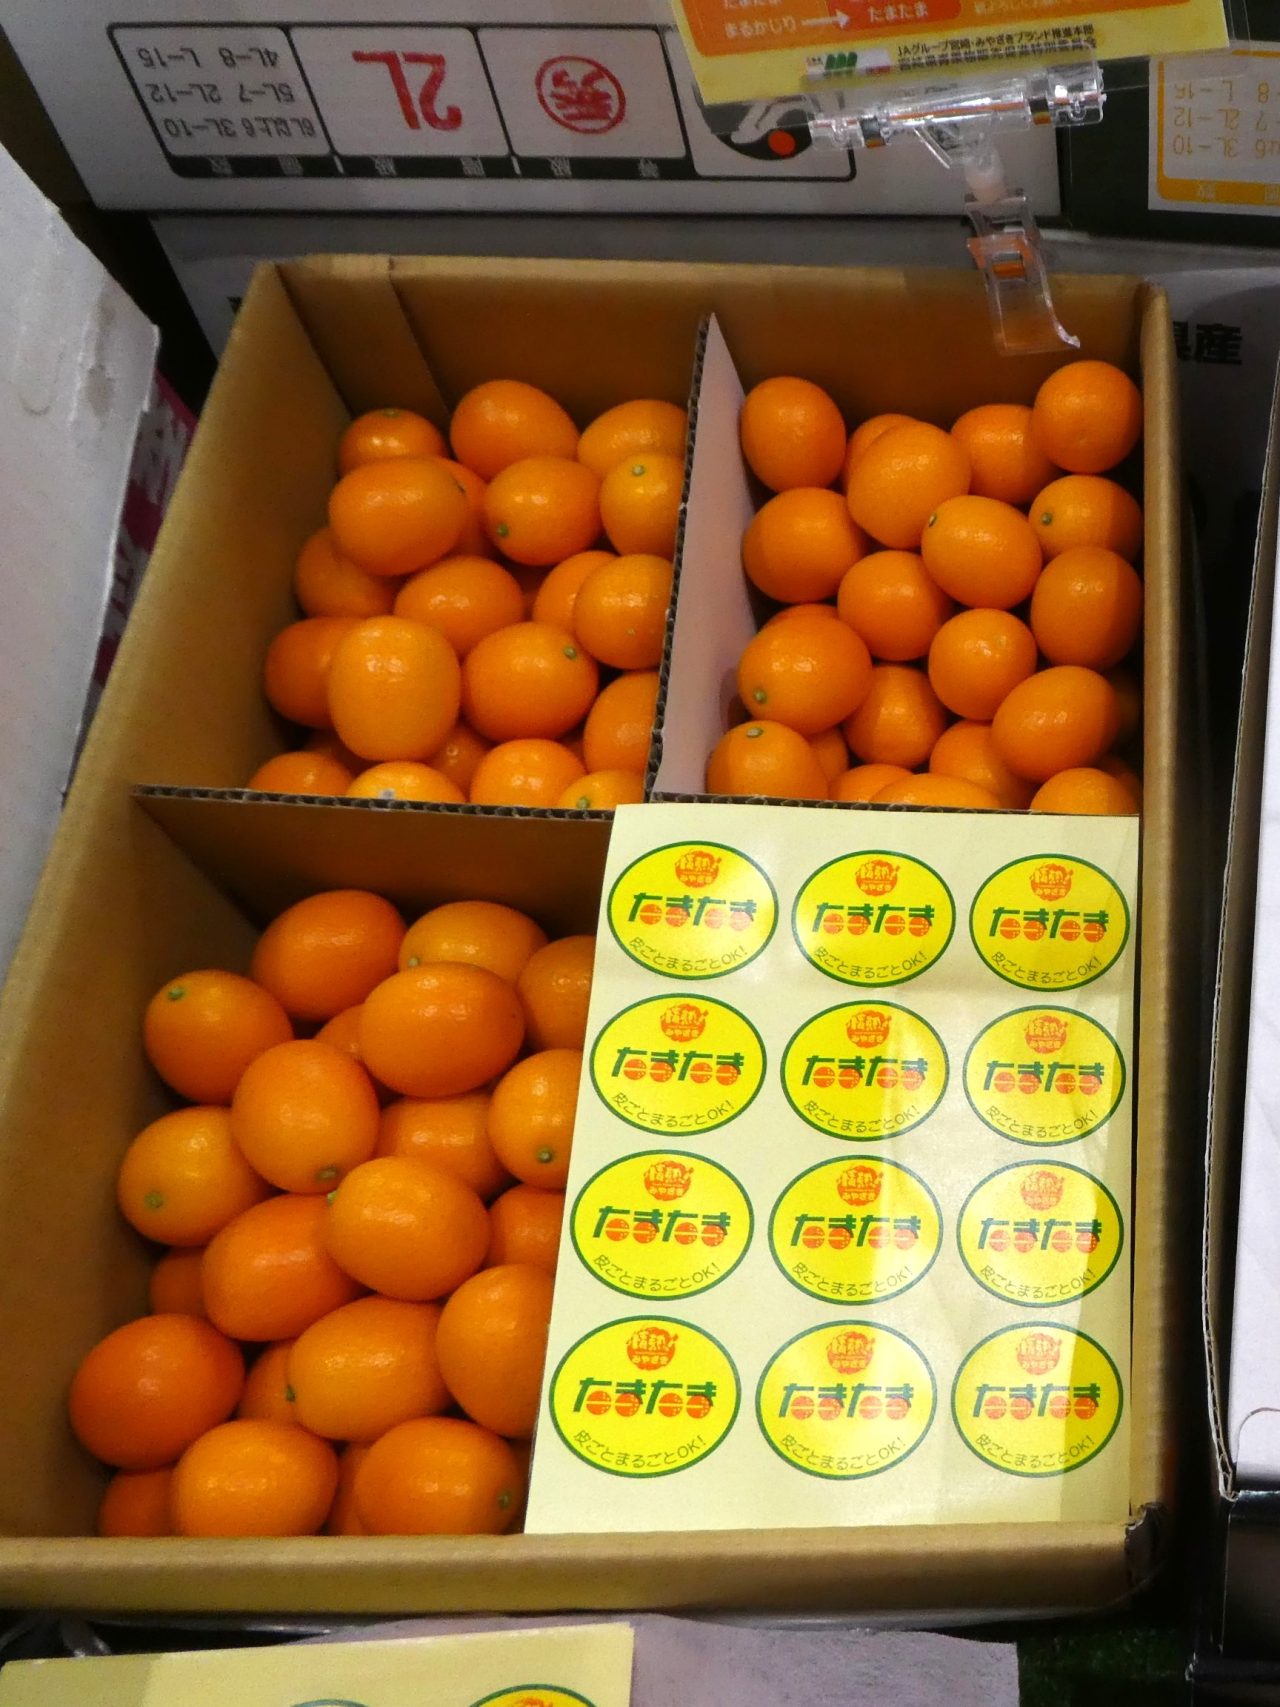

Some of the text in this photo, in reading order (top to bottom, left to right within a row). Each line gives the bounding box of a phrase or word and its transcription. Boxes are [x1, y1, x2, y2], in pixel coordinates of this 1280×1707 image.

[352, 50, 463, 131] 2L
[629, 892, 757, 931] たまたま
[811, 902, 935, 937] たまたま
[990, 906, 1109, 943] たまたま
[629, 937, 749, 971] 皮ごとまるごとOK!
[813, 945, 927, 979] 皮ごとまるごとOK!
[991, 951, 1101, 983] 皮ごとまるごとOK!
[611, 1047, 745, 1085] たまたま
[802, 1055, 928, 1091] たまたま
[984, 1061, 1104, 1095] たまたま
[612, 1092, 733, 1127] 皮ごとまるごとOK!
[804, 1100, 920, 1133] 皮ごとまるごとOK!
[985, 1106, 1098, 1139] 皮ごとまるごとOK!
[593, 1207, 731, 1247] たまたま
[791, 1213, 922, 1250] たまたま
[978, 1218, 1103, 1253] たまたま
[593, 1254, 721, 1292] 皮ごとまるごとOK!
[792, 1262, 914, 1297] 皮ごとまるごとOK!
[980, 1265, 1096, 1299] 皮ごとまるごとOK!
[573, 1377, 717, 1417] たまたま
[779, 1383, 914, 1421] たまたま
[973, 1383, 1101, 1421] たまたま
[574, 1429, 706, 1468] 皮ごとまるごとOK!
[780, 1435, 906, 1471] 皮ごとまるごとOK!
[975, 1433, 1095, 1469] 皮ごとまるごとOK!
